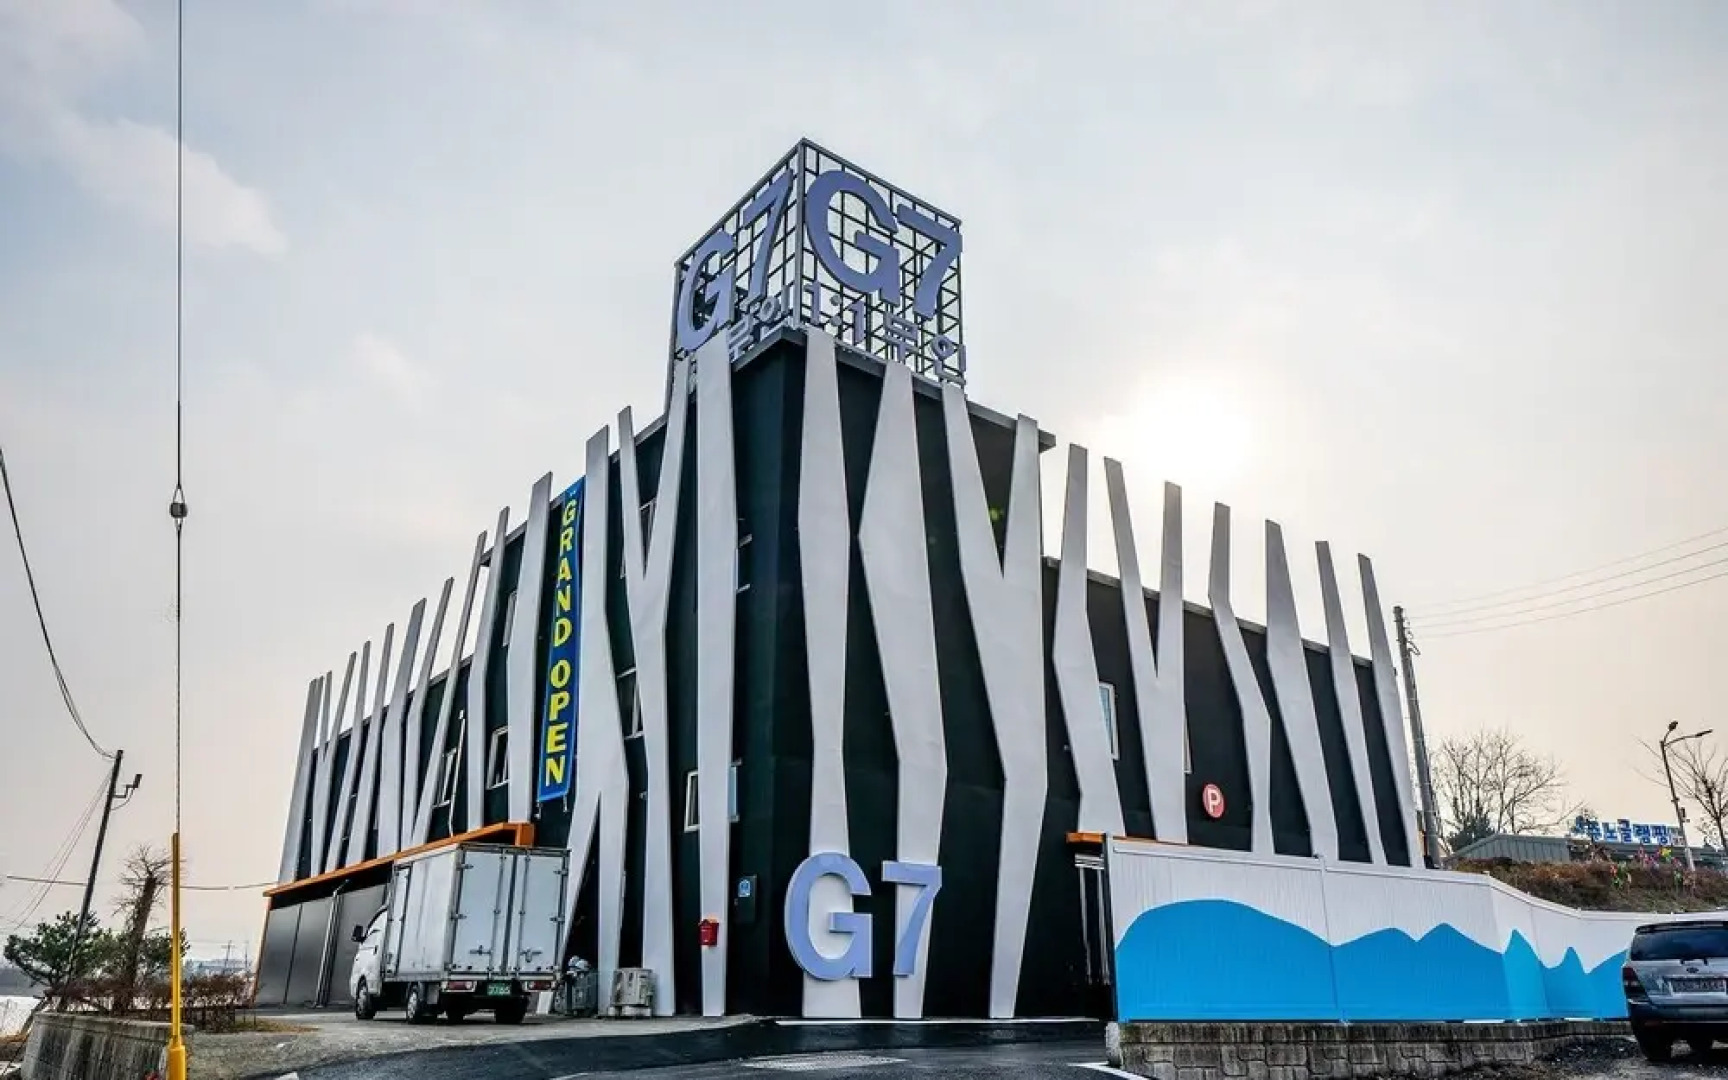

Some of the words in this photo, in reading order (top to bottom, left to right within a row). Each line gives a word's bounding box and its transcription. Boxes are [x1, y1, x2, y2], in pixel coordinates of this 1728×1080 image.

[677, 168, 793, 350] G7
[805, 170, 963, 320] G7
[554, 499, 576, 647] GRAND
[546, 659, 571, 787] OPEN
[1207, 789, 1221, 813] P
[784, 852, 943, 981] G7
